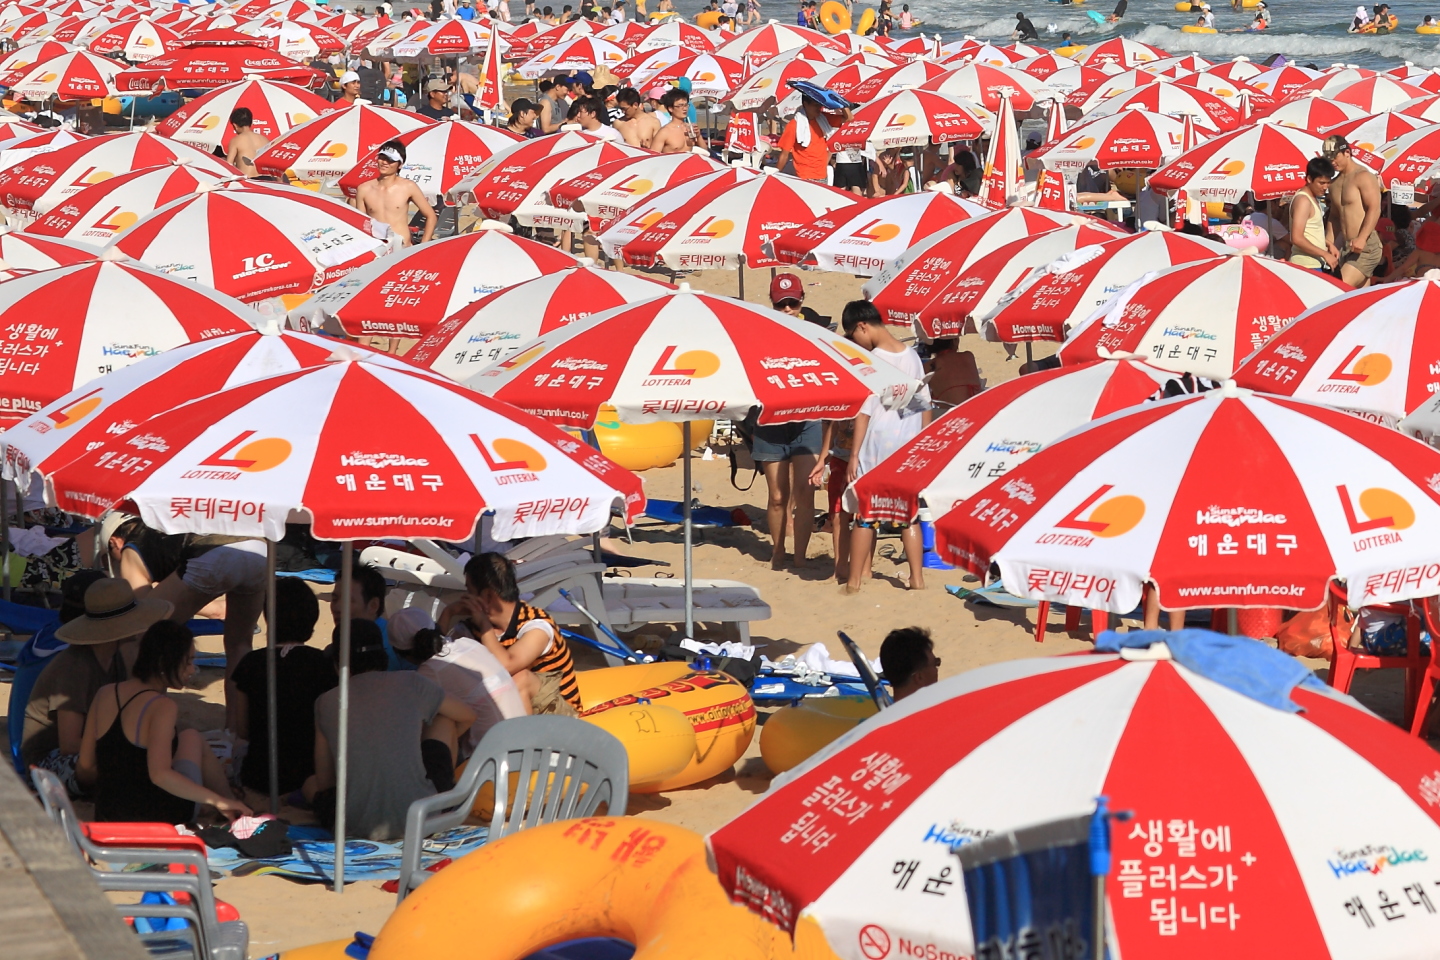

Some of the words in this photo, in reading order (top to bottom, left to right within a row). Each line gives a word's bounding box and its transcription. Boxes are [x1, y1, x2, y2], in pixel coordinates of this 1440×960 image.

[1108, 142, 1152, 153] 해운대구
[453, 155, 484, 164] 생활에
[678, 253, 727, 269] 롯데리아
[833, 253, 886, 271] 롯데리아
[397, 267, 439, 282] 생활에
[379, 282, 431, 295] 플러스가
[1033, 284, 1072, 297] 플러스가
[384, 295, 422, 309] 됩니다
[4, 321, 60, 342] 생활에
[361, 319, 397, 334] Home
[397, 320, 420, 336] plus
[1011, 323, 1037, 335] Home
[1036, 324, 1054, 338] plus
[1152, 343, 1218, 362] 해운대구
[533, 372, 604, 390] 해운대구
[641, 378, 692, 387] LOTTERIA
[766, 371, 840, 390] 해운대구
[1317, 383, 1361, 395] LOTTERIA
[640, 398, 727, 416] 롯데리아
[773, 403, 852, 418] www.sunnfun.co.kr
[341, 455, 430, 468] Haeundae
[180, 470, 242, 481] LOTTERIA
[335, 472, 444, 493] 해운대구
[494, 472, 541, 486] LOTTERIA
[170, 496, 267, 524] 롯데리아
[511, 495, 590, 527] 롯데리아
[332, 514, 455, 529] www.sunnfun.co.kr
[1196, 511, 1288, 527] Haeundae
[1035, 532, 1095, 549] LOTTERIA
[1187, 533, 1298, 557] 해운대구
[1353, 532, 1404, 553] LOTTERIA
[1027, 561, 1118, 603] 롯데리아
[1178, 583, 1306, 598] www.sunnfun.co.kr
[850, 751, 914, 797] 생활에
[802, 776, 867, 827] 플러스가
[779, 811, 838, 856] 됩니다
[1128, 819, 1231, 854] 생활에
[1325, 846, 1430, 879] Haeundae
[1117, 859, 1239, 896] 플러스가
[1148, 896, 1242, 935] 됩니다
